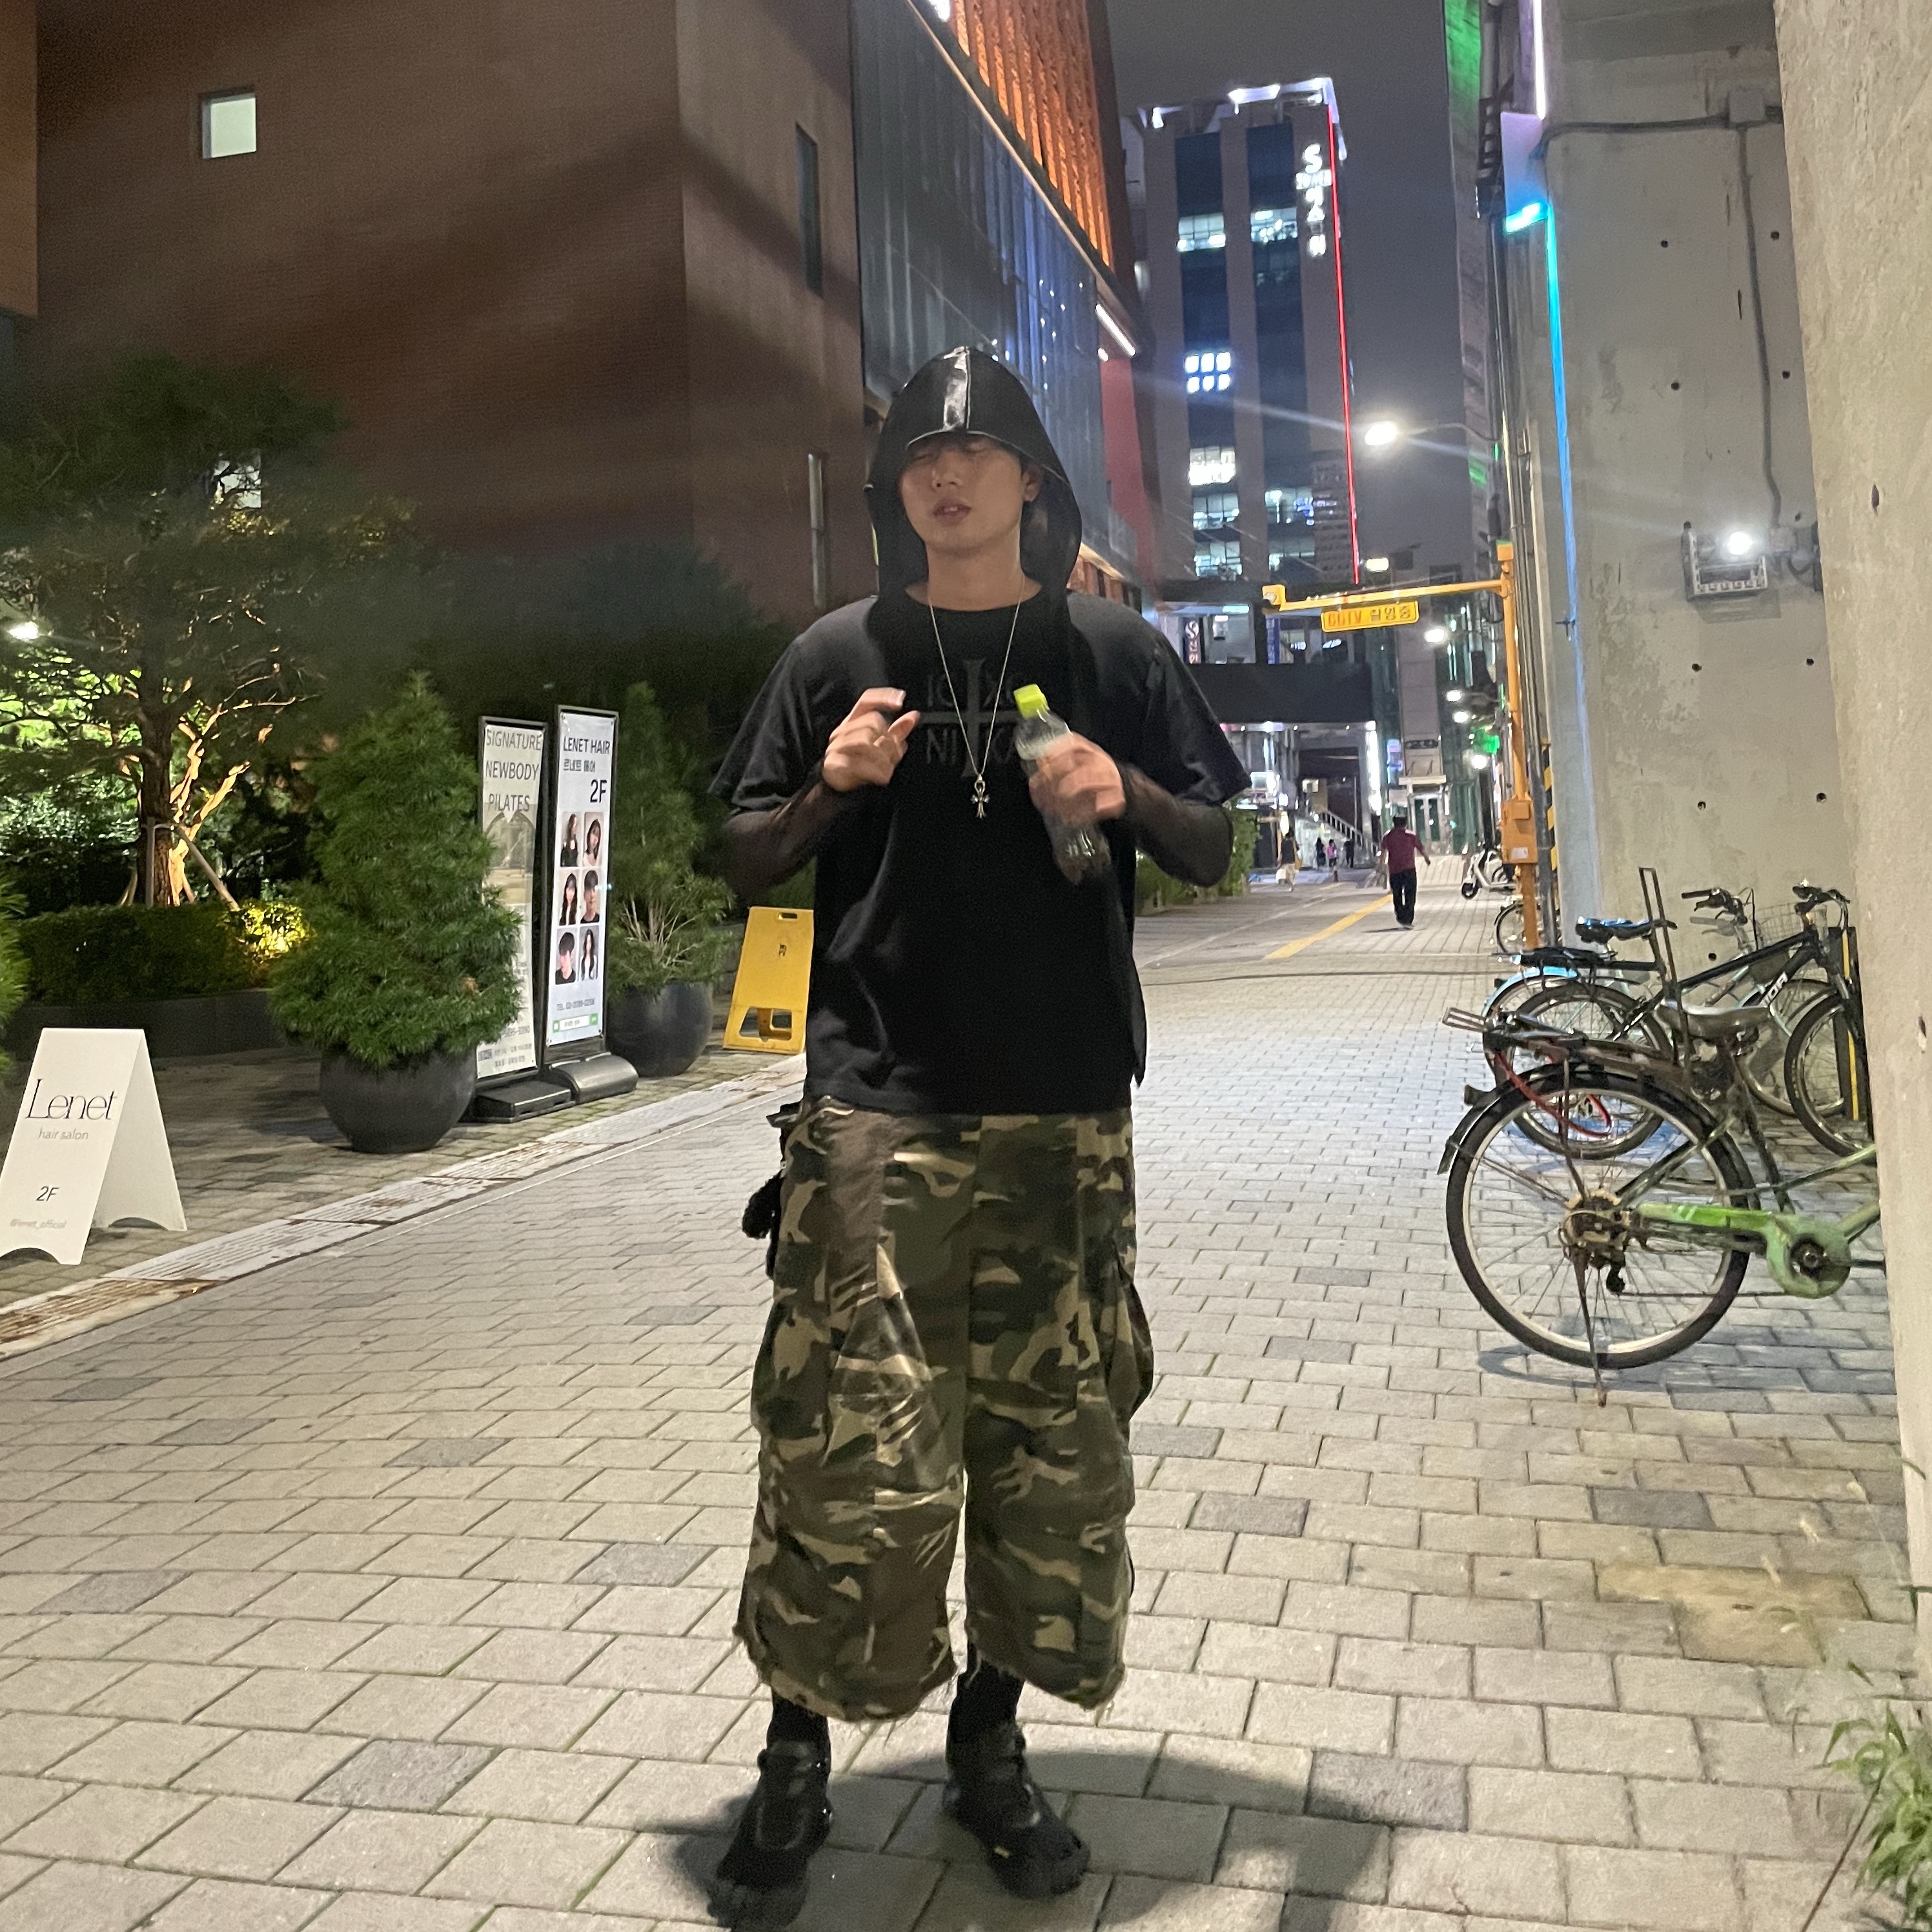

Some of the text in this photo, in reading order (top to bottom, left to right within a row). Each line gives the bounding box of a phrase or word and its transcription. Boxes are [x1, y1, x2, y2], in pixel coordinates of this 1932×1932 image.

[1302, 143, 1323, 174] S
[486, 729, 541, 751] SIGNATURE
[563, 736, 611, 755] LENET HAIR
[485, 760, 540, 781] NEWBODY
[590, 778, 607, 803] 2F
[488, 793, 530, 812] PILATES
[26, 1078, 117, 1120] Lenet
[37, 1126, 89, 1140] hair salon
[36, 1186, 60, 1202] 2F
